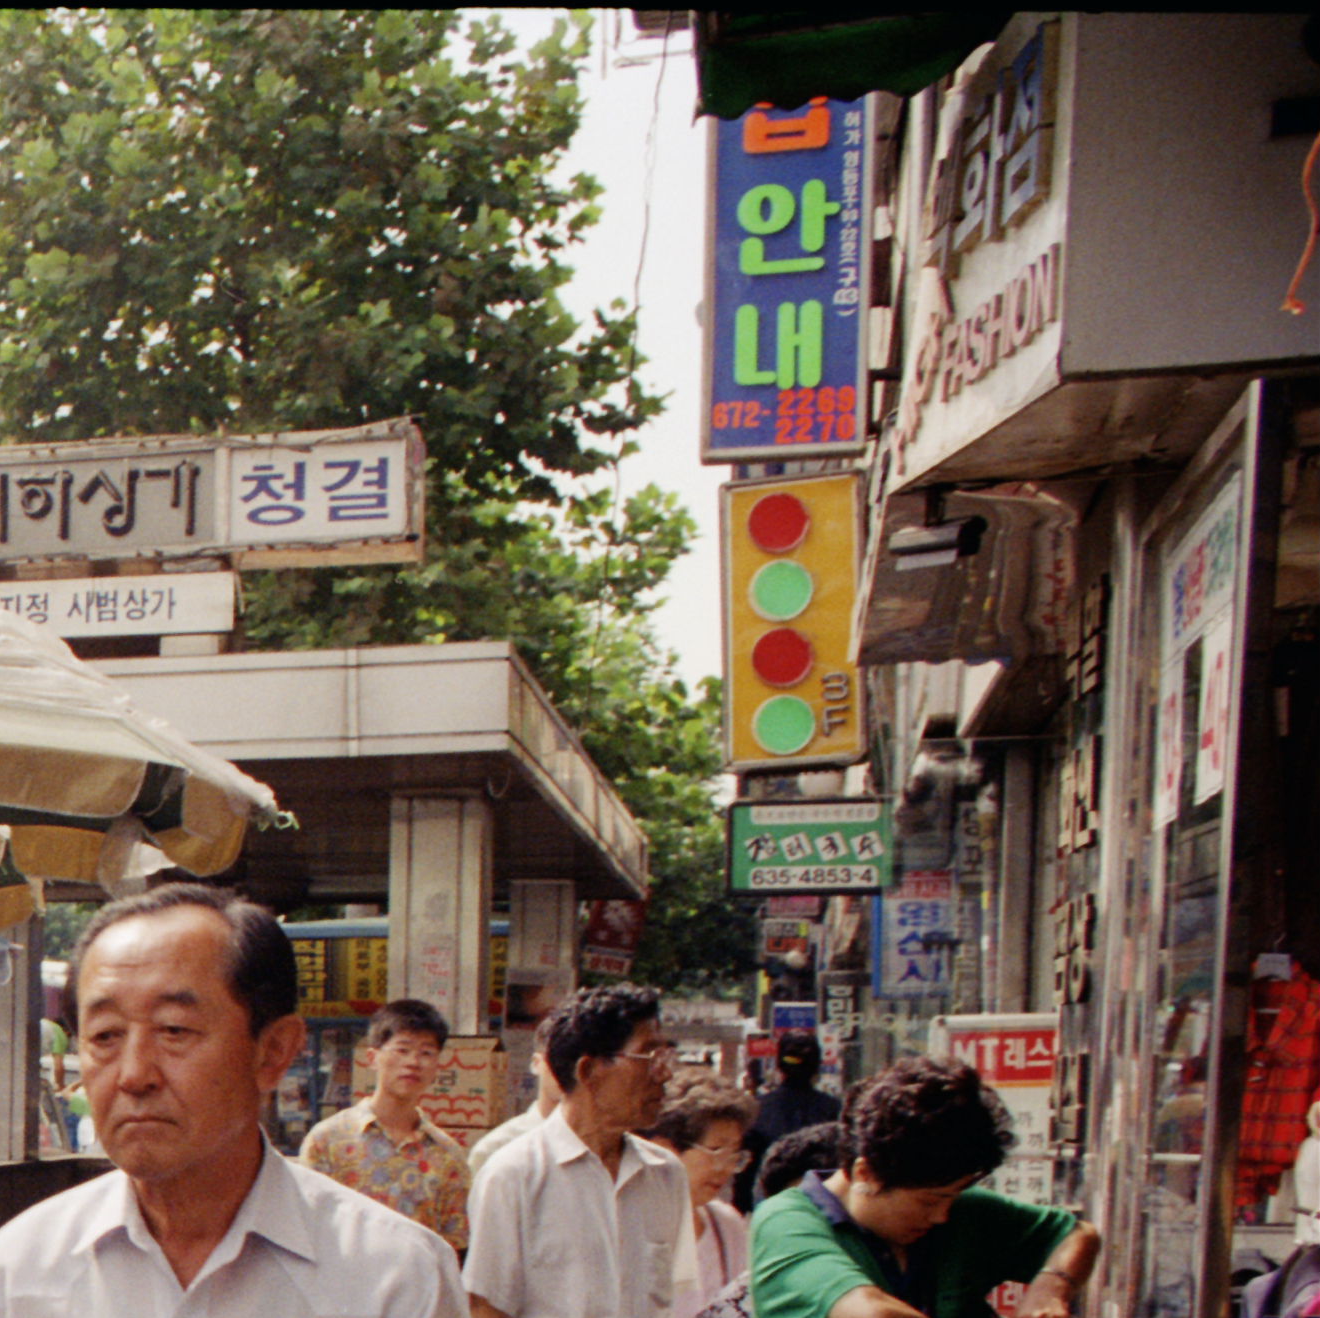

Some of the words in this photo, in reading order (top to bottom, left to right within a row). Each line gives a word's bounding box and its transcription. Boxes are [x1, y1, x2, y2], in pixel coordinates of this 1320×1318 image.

[942, 243, 1061, 402] FASHION
[775, 414, 857, 444] 2270
[241, 455, 391, 525] 청결
[751, 867, 874, 885] 635-4853-4
[953, 1037, 1059, 1070] MT레스
